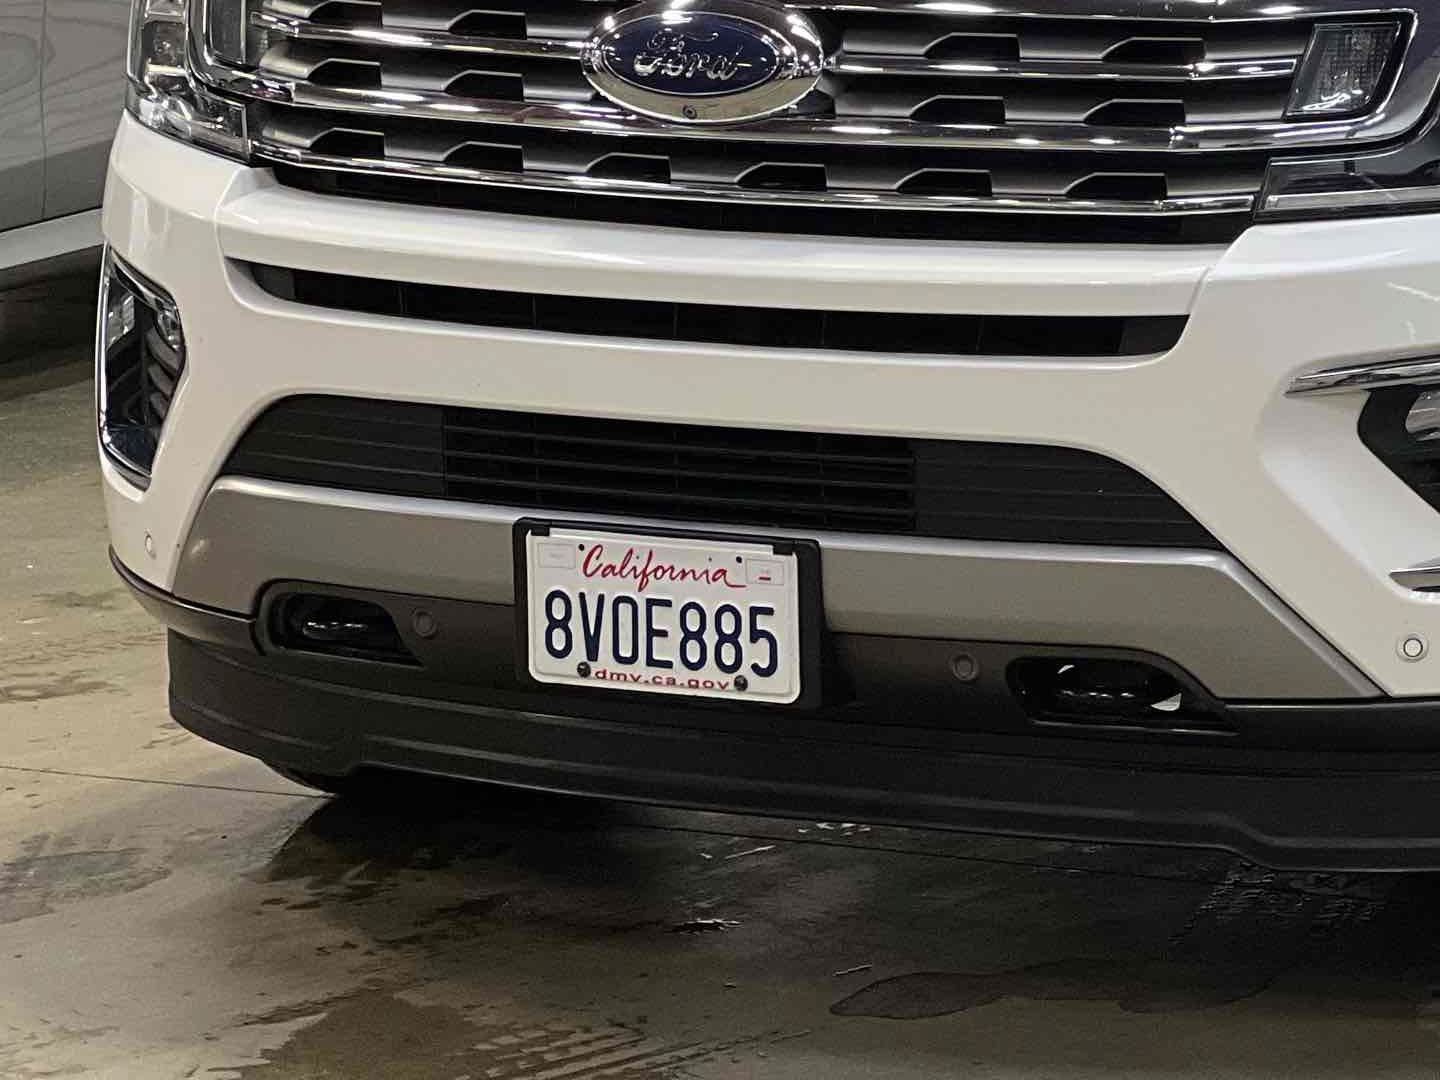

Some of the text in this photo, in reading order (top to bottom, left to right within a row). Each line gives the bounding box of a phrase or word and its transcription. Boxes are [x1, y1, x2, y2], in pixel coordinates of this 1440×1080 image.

[633, 27, 753, 81] Ford
[582, 544, 747, 592] California
[544, 589, 778, 677] 8VOE885
[594, 668, 730, 691] dmv.ca.gov
